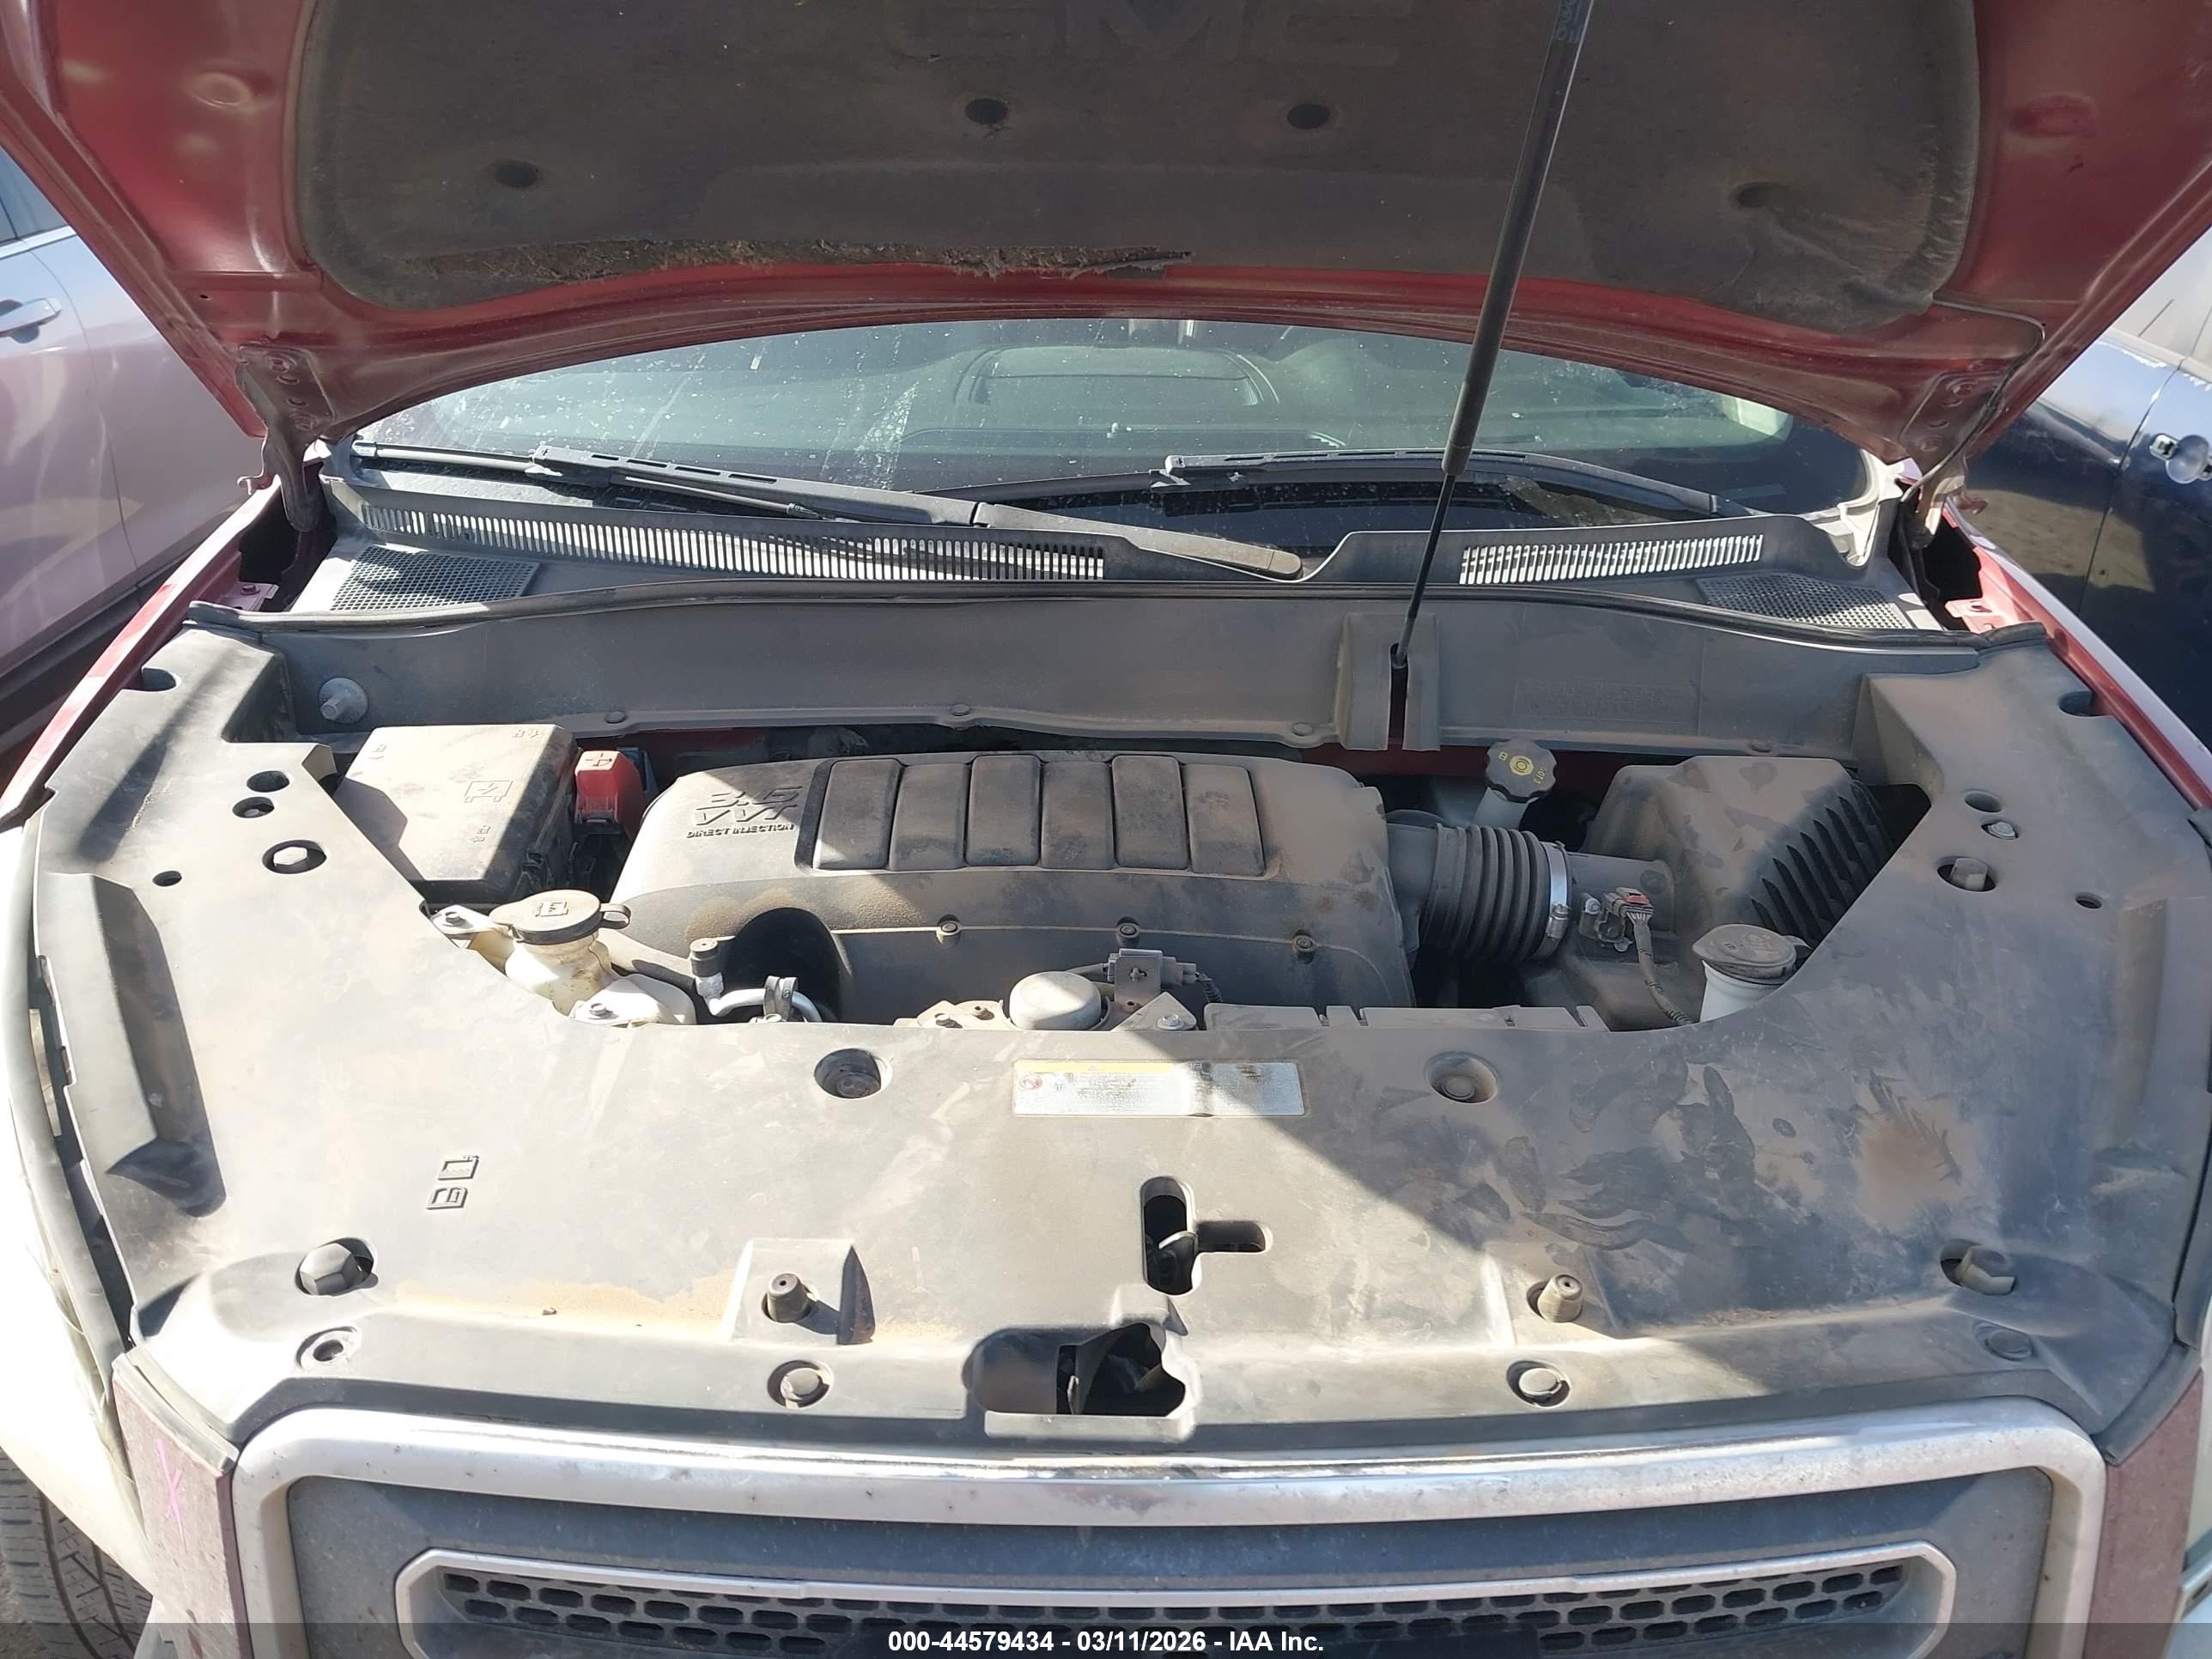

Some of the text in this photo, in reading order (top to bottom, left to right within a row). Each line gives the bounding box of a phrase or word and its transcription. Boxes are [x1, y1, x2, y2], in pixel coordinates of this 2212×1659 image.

[696, 785, 804, 810] 3.6
[695, 803, 798, 826] VVT
[686, 823, 795, 839] DIRECT INJECTION
